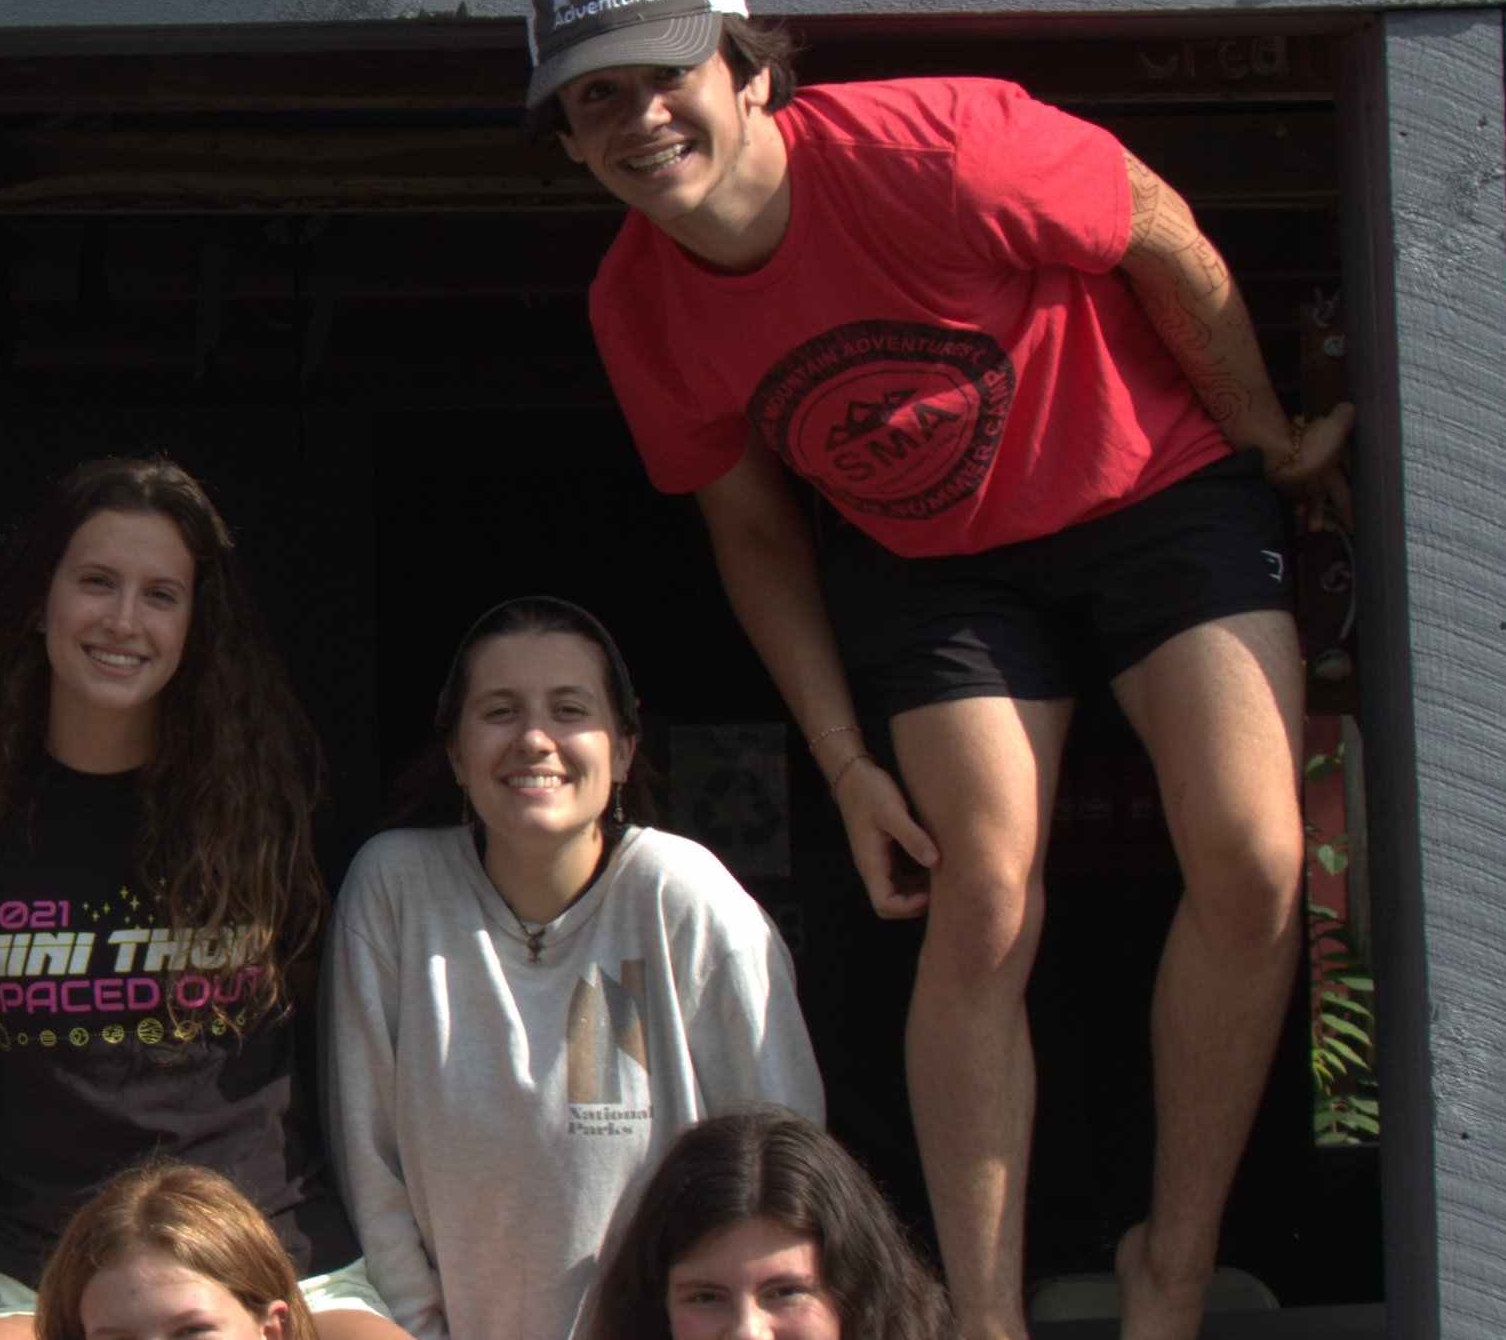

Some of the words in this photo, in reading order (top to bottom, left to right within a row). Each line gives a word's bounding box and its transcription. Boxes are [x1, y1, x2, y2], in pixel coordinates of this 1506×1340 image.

[832, 403, 963, 483] SMA
[175, 965, 264, 1010] OUT
[569, 1106, 654, 1120] National
[567, 1121, 633, 1136] Parks
